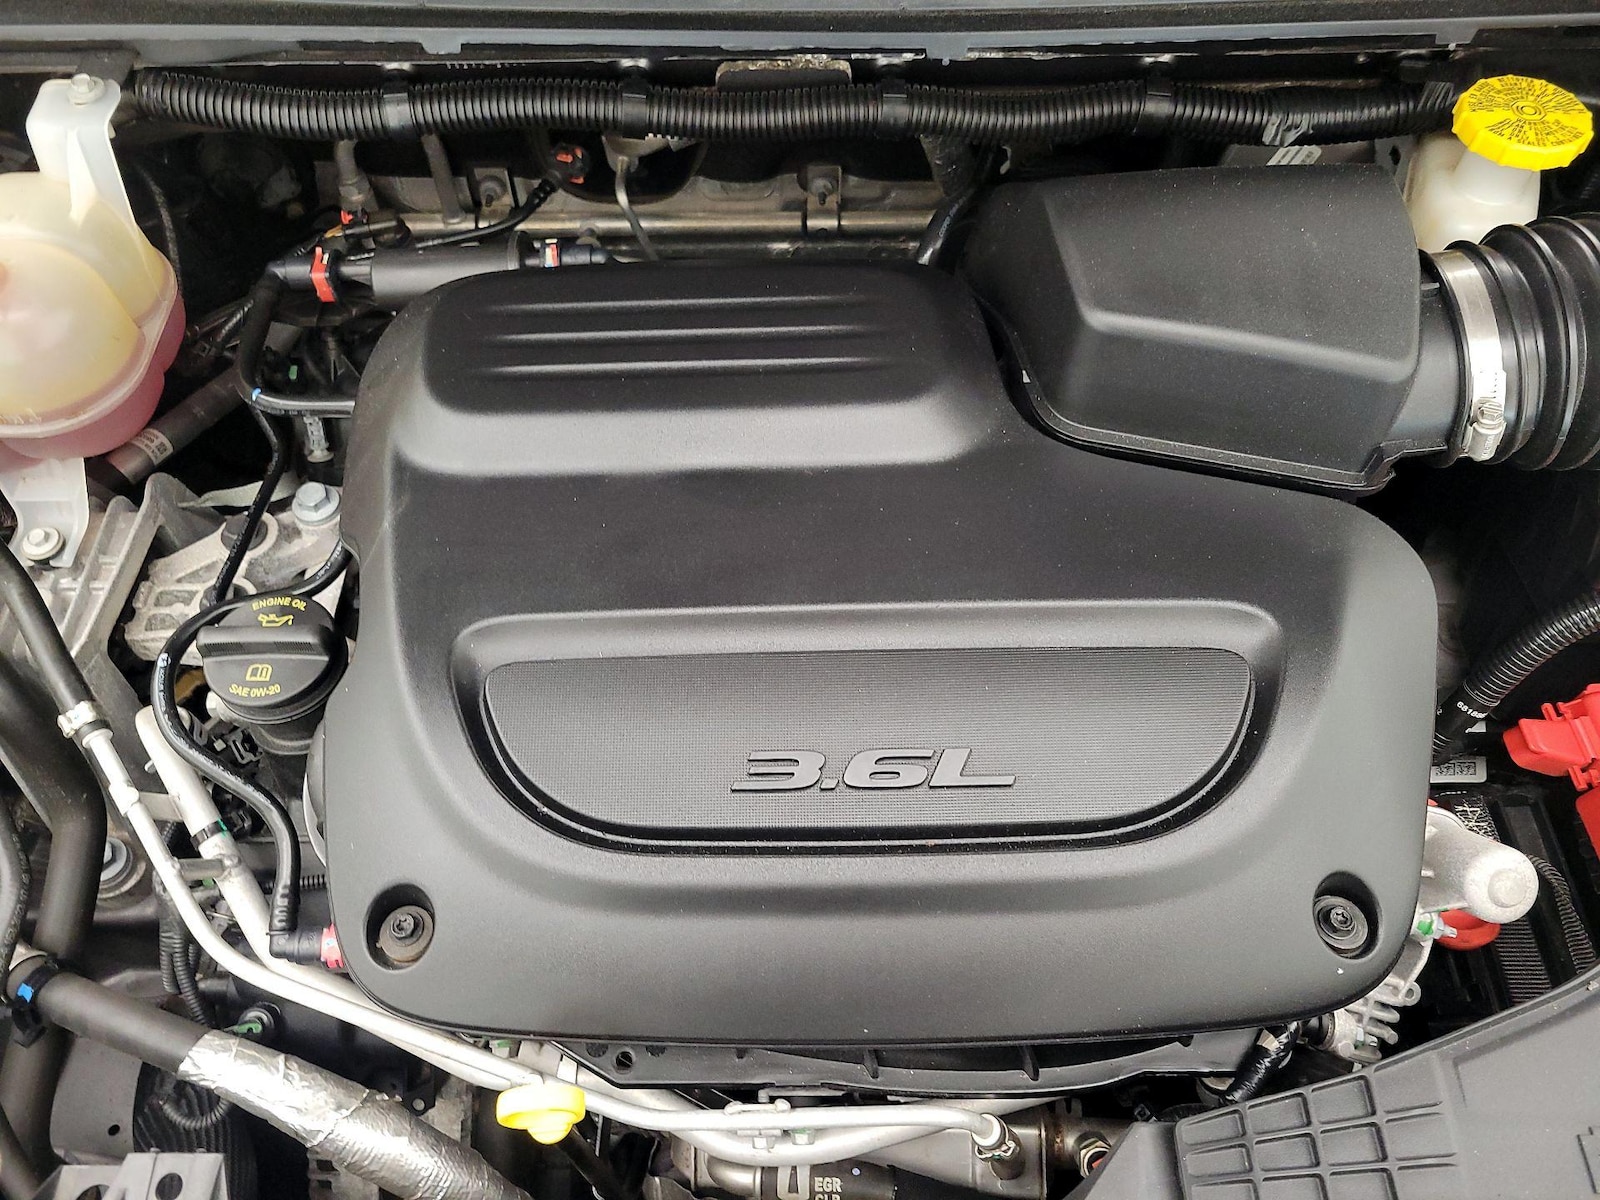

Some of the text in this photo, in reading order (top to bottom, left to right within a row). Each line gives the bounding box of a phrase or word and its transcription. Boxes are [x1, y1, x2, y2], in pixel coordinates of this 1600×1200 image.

[252, 597, 307, 612] ENGINE OIL
[228, 683, 281, 697] SAE 0W-20
[730, 747, 1017, 792] 3.6L
[814, 1176, 842, 1193] EGR
